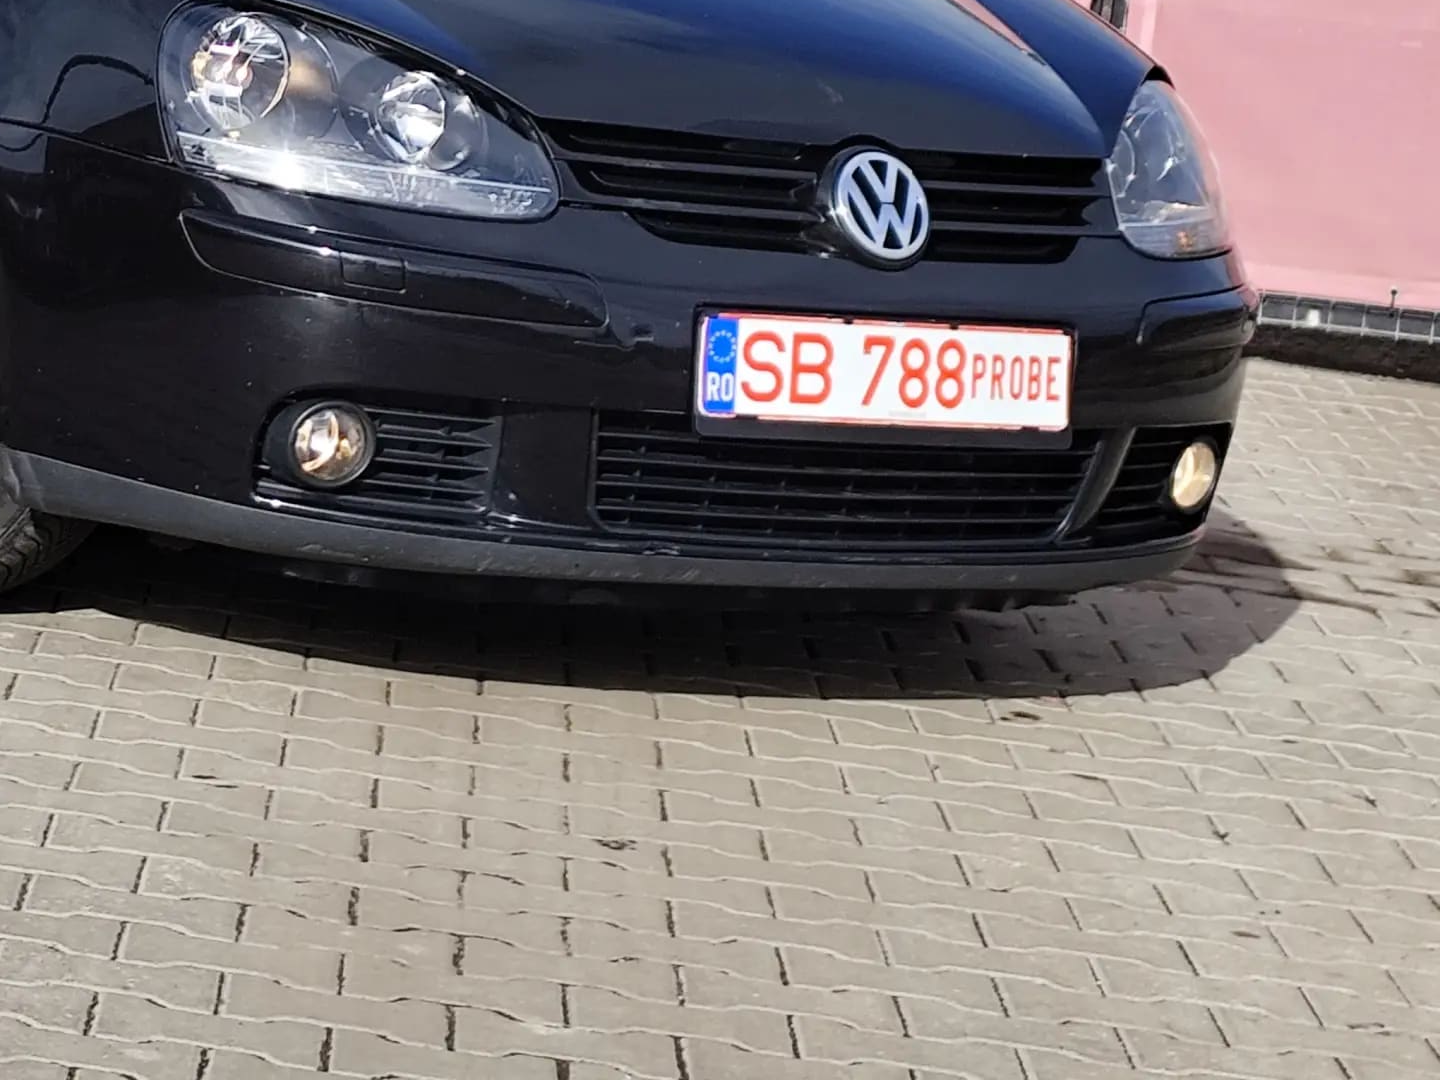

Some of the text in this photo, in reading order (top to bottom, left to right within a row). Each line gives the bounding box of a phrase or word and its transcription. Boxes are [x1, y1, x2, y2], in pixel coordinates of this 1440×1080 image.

[838, 151, 929, 260] VW
[707, 371, 735, 402] RO
[741, 330, 1061, 409] SB 788 PROBE
